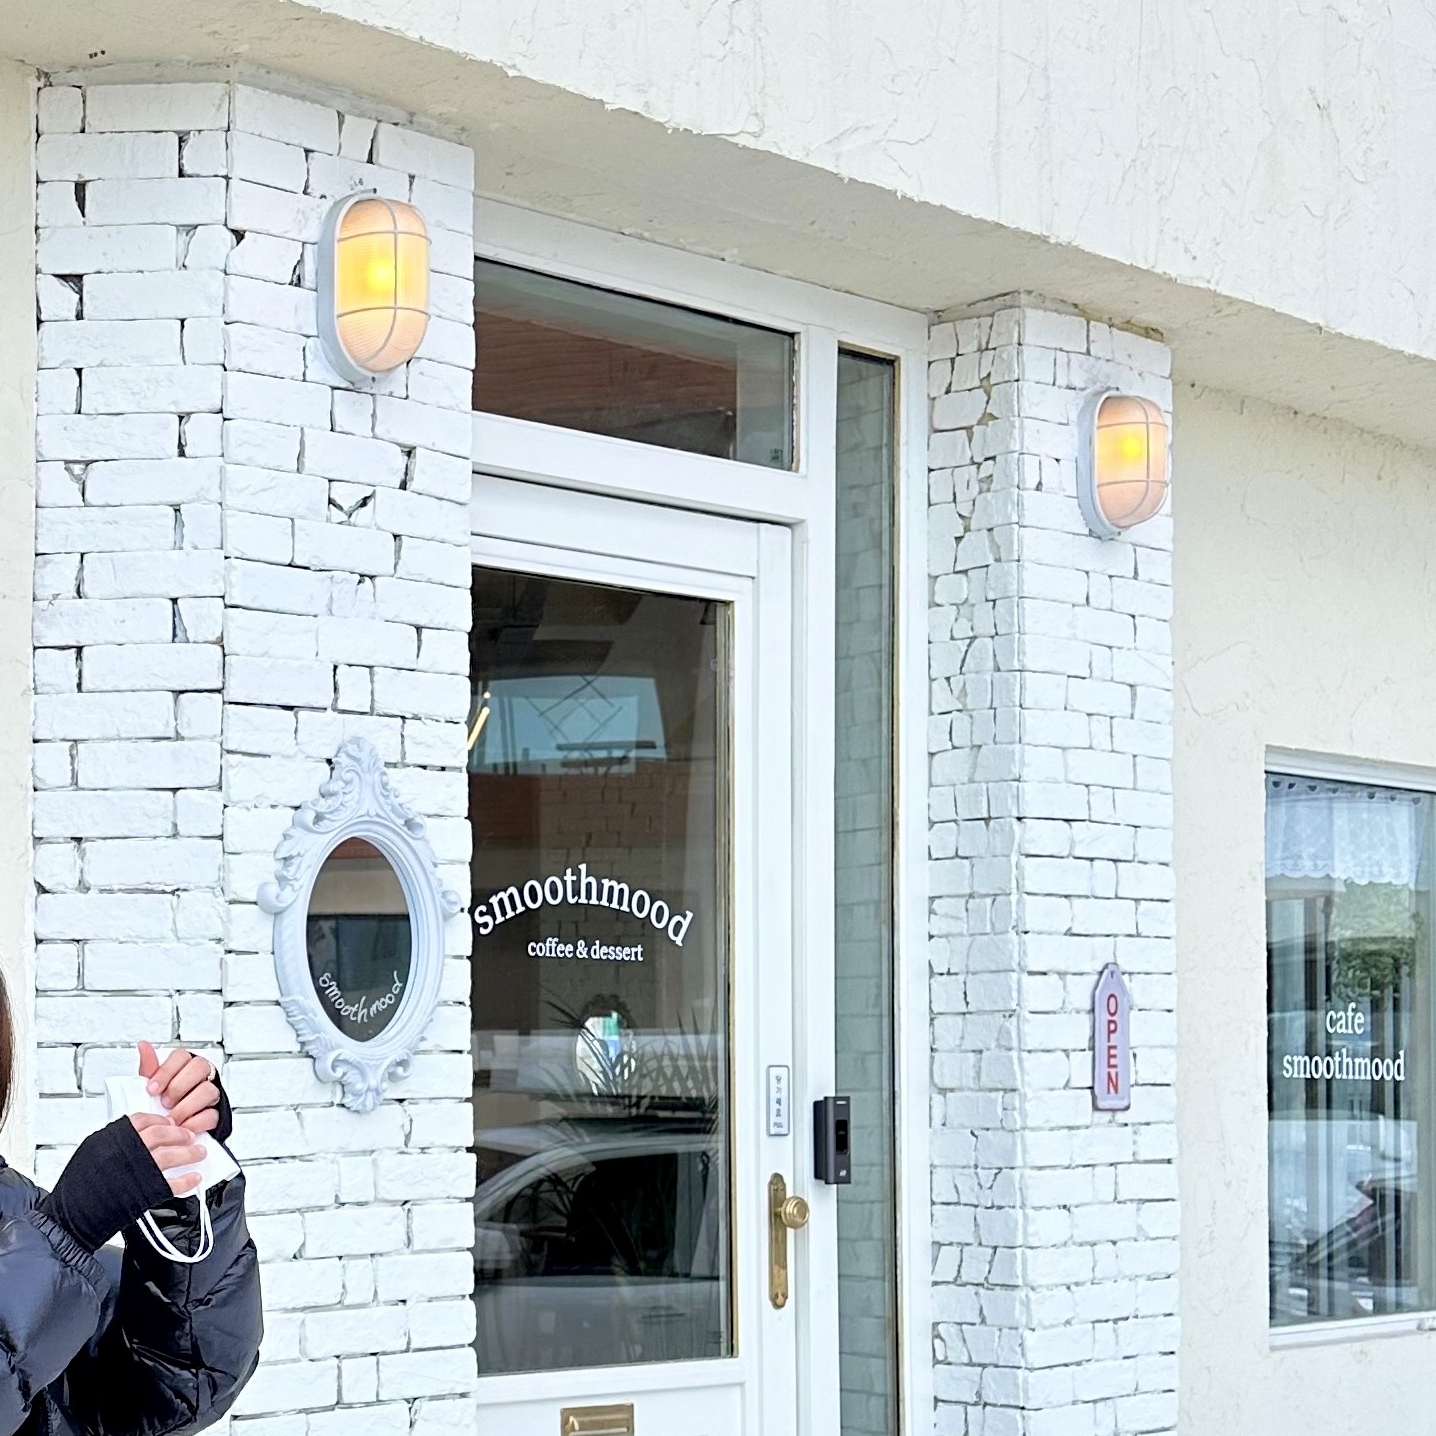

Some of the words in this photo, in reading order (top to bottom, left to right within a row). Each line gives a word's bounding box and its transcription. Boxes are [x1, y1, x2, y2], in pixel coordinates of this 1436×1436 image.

[474, 863, 693, 946] smoothmood
[527, 937, 573, 958] coffee
[576, 940, 588, 959] &
[591, 940, 643, 961] dessert
[1326, 1002, 1365, 1035] cafe
[1107, 993, 1119, 1095] OPEN
[1282, 1048, 1406, 1082] smoothmood
